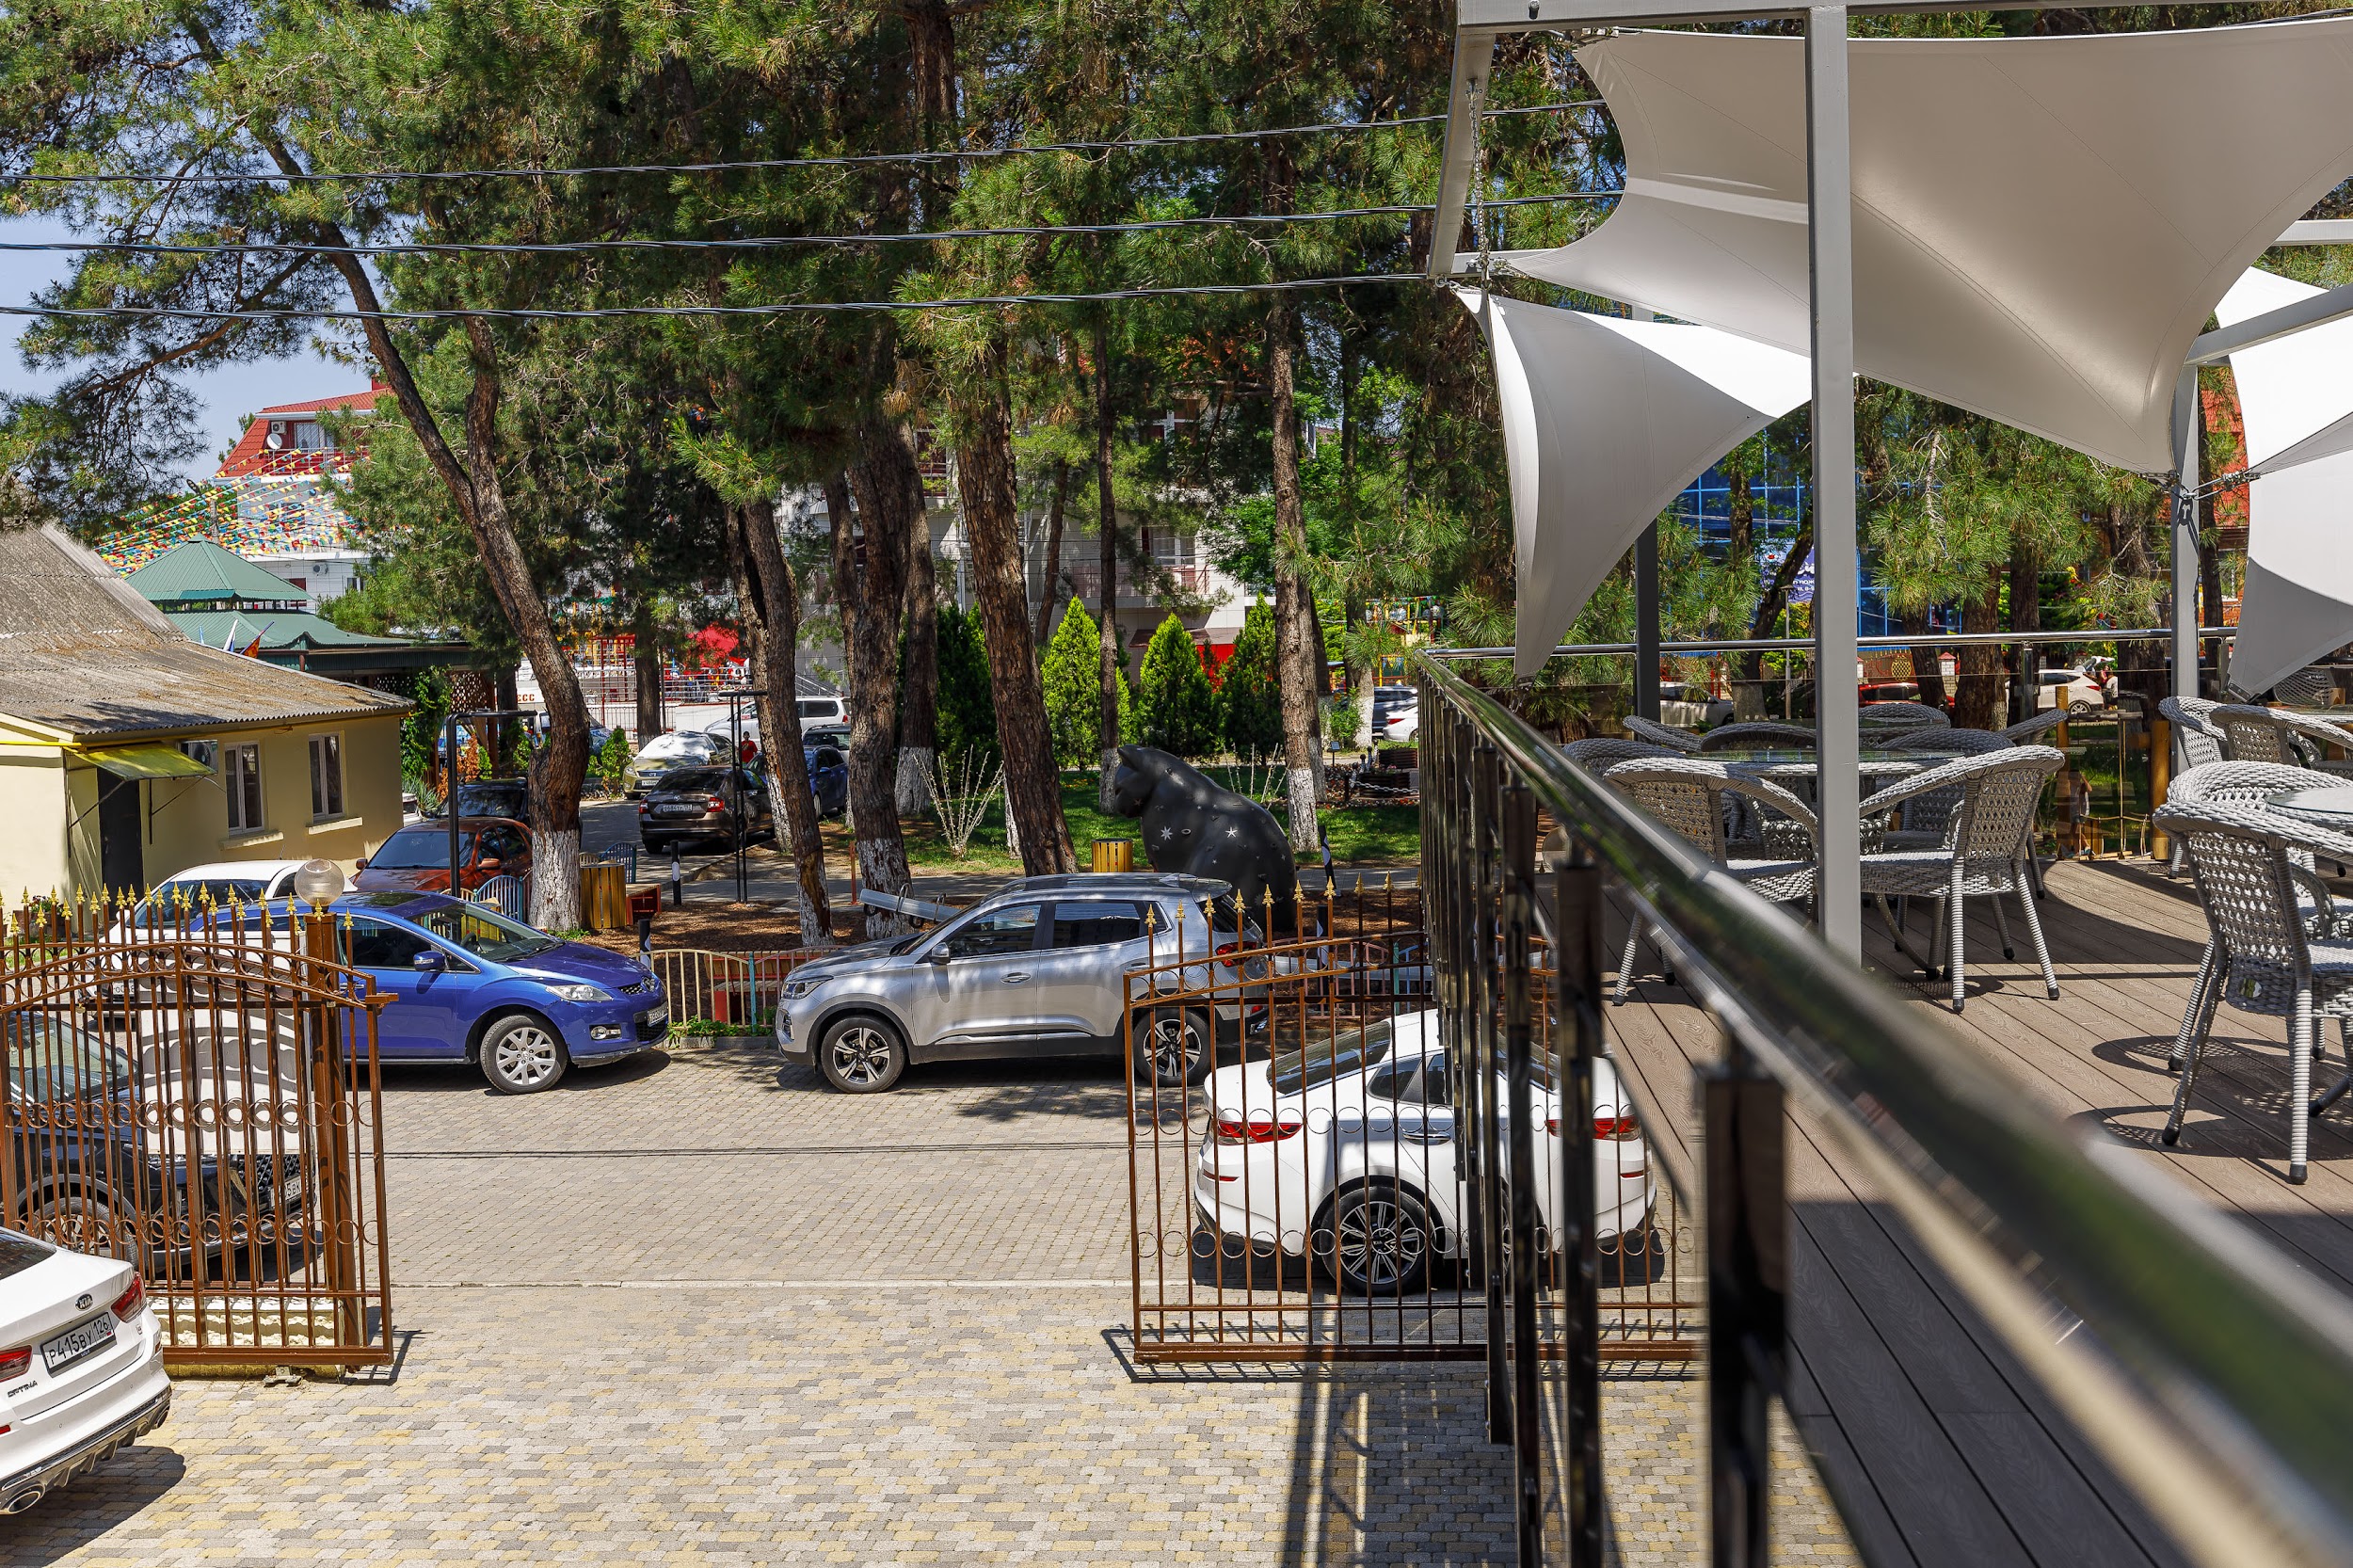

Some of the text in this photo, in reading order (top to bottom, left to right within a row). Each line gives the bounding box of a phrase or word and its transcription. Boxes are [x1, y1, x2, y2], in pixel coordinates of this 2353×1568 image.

[517, 694, 535, 702] ЕСС
[78, 1295, 92, 1309] KIA
[94, 1317, 110, 1336] 126
